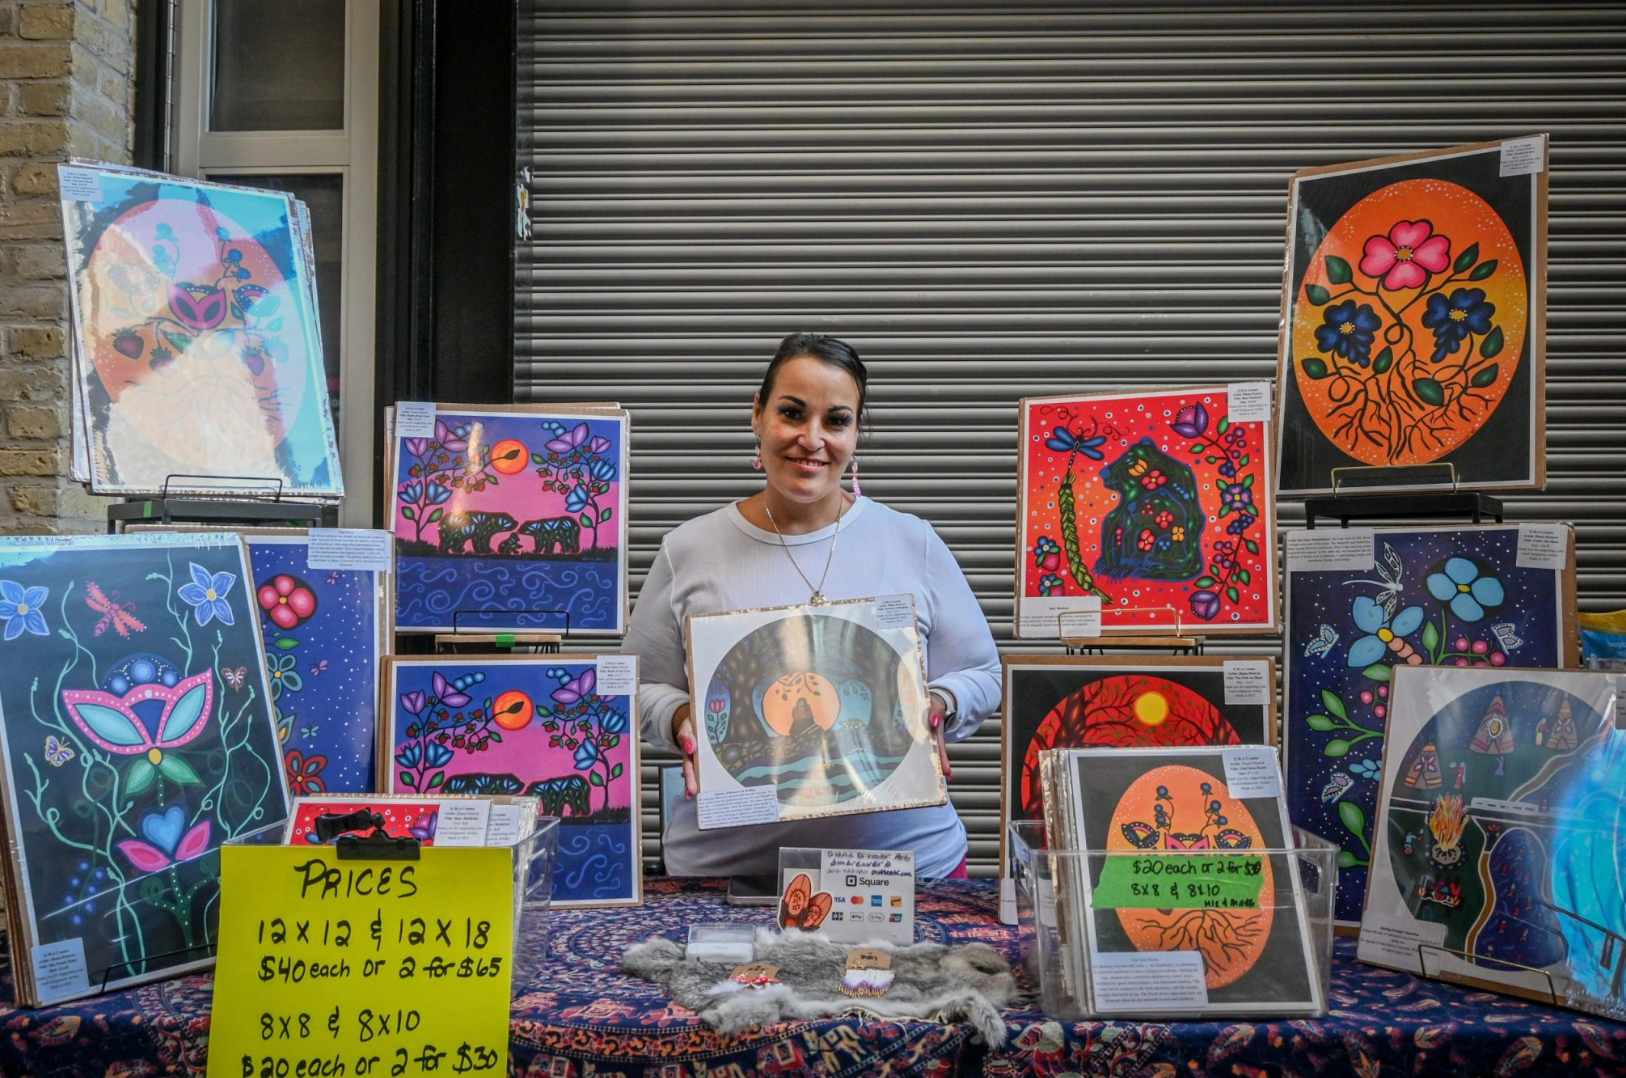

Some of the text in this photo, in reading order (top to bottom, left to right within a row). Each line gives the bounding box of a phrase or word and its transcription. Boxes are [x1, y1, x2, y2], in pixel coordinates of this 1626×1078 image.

[293, 858, 418, 899] PRICES
[1132, 859, 1163, 875] $20
[1165, 859, 1197, 875] each
[1201, 862, 1215, 873] or
[1217, 861, 1226, 874] 2
[1227, 861, 1243, 874] for
[859, 877, 890, 887] Square
[257, 955, 503, 983] $40 each or 2 for $65
[296, 1054, 345, 1078] each
[355, 1056, 380, 1076] or
[391, 1048, 408, 1077] 2
[414, 1045, 447, 1072] for
[452, 1041, 498, 1073] $30
